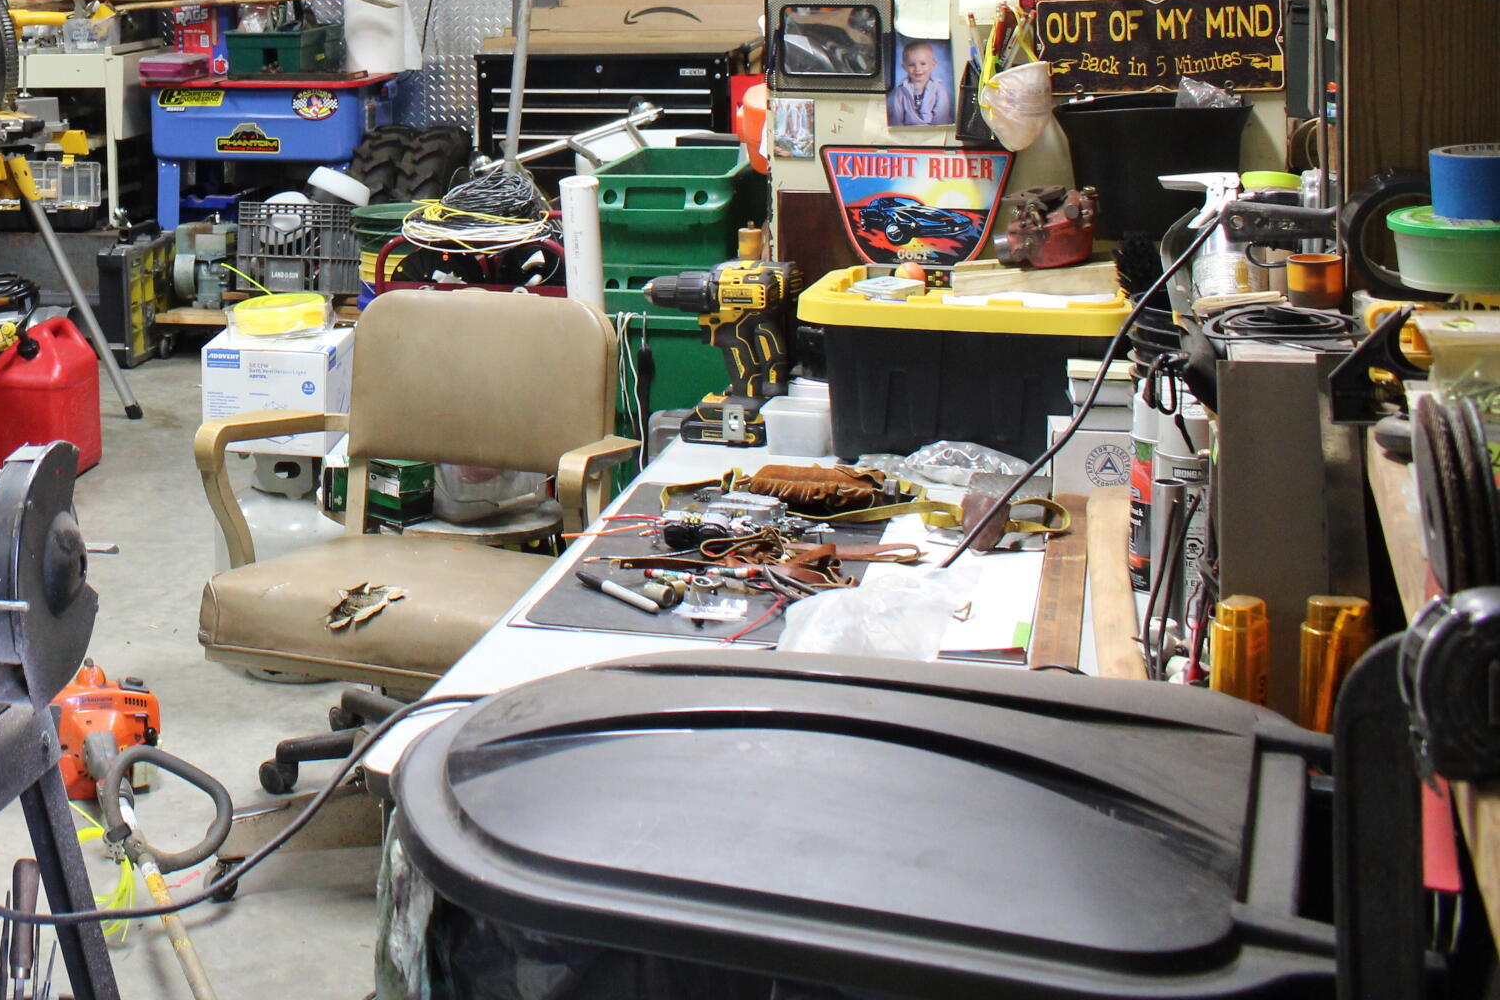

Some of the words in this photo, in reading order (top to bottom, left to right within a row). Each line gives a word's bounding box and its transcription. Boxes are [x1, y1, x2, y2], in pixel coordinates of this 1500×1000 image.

[175, 7, 210, 26] RAGS
[1046, 10, 1098, 45] OUT
[1108, 8, 1144, 43] OF
[1156, 7, 1194, 40] MY
[1205, 3, 1273, 39] MIND
[1078, 52, 1120, 76] Back
[1127, 57, 1148, 77] in
[1156, 56, 1167, 77] 5
[1175, 51, 1243, 76] Minutes
[218, 138, 279, 148] PHANTOM
[835, 155, 918, 180] KNIGHT
[928, 156, 994, 181] RIDER
[1099, 456, 1119, 474] A
